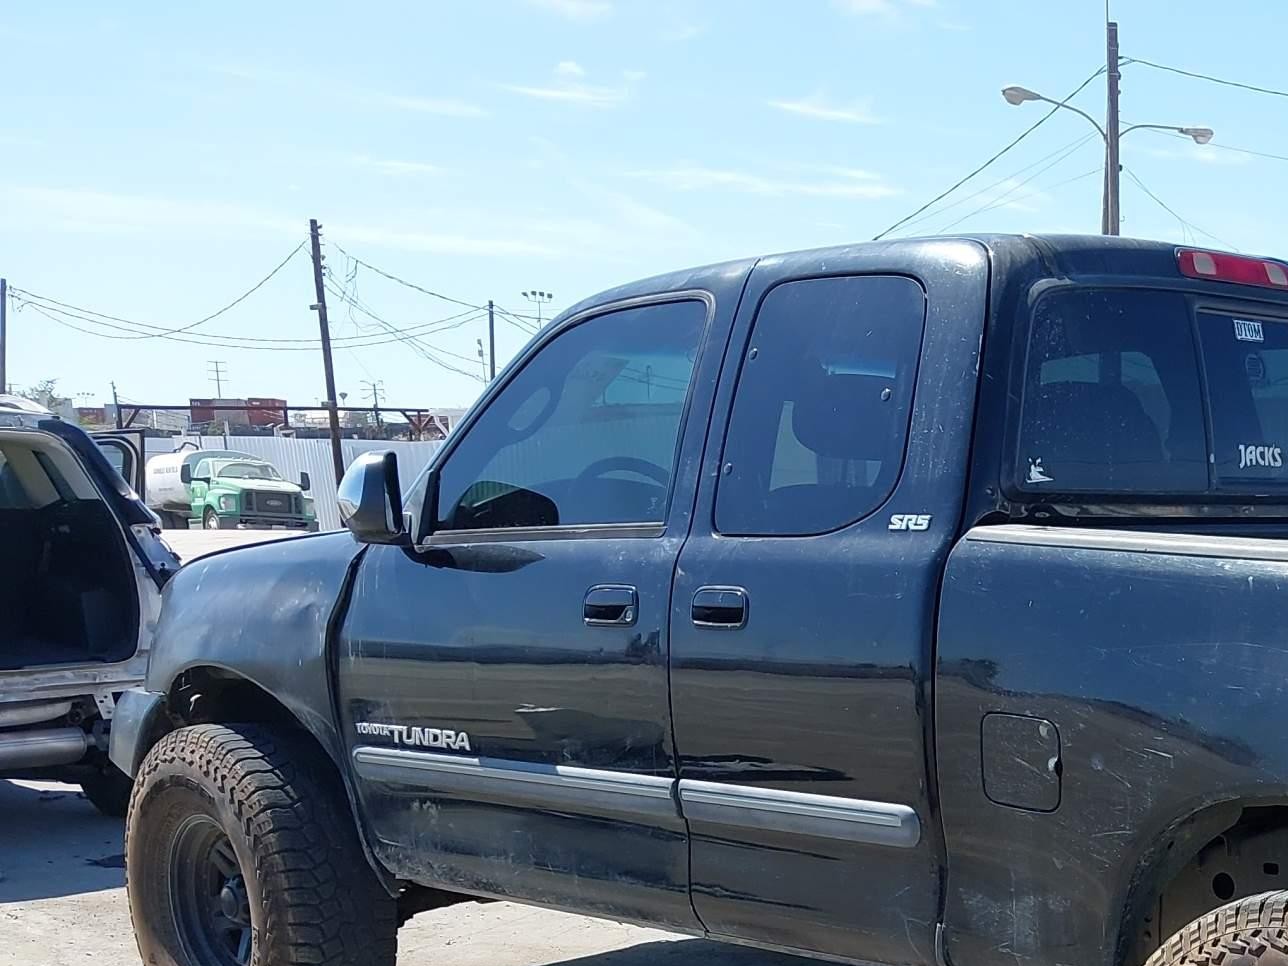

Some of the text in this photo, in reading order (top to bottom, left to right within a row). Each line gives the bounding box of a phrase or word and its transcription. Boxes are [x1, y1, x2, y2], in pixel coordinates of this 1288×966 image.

[1234, 321, 1264, 339] DTOM
[1238, 443, 1283, 469] JACK'S
[888, 513, 932, 531] SR5
[355, 722, 471, 751] TOYOTA TUNDRA
